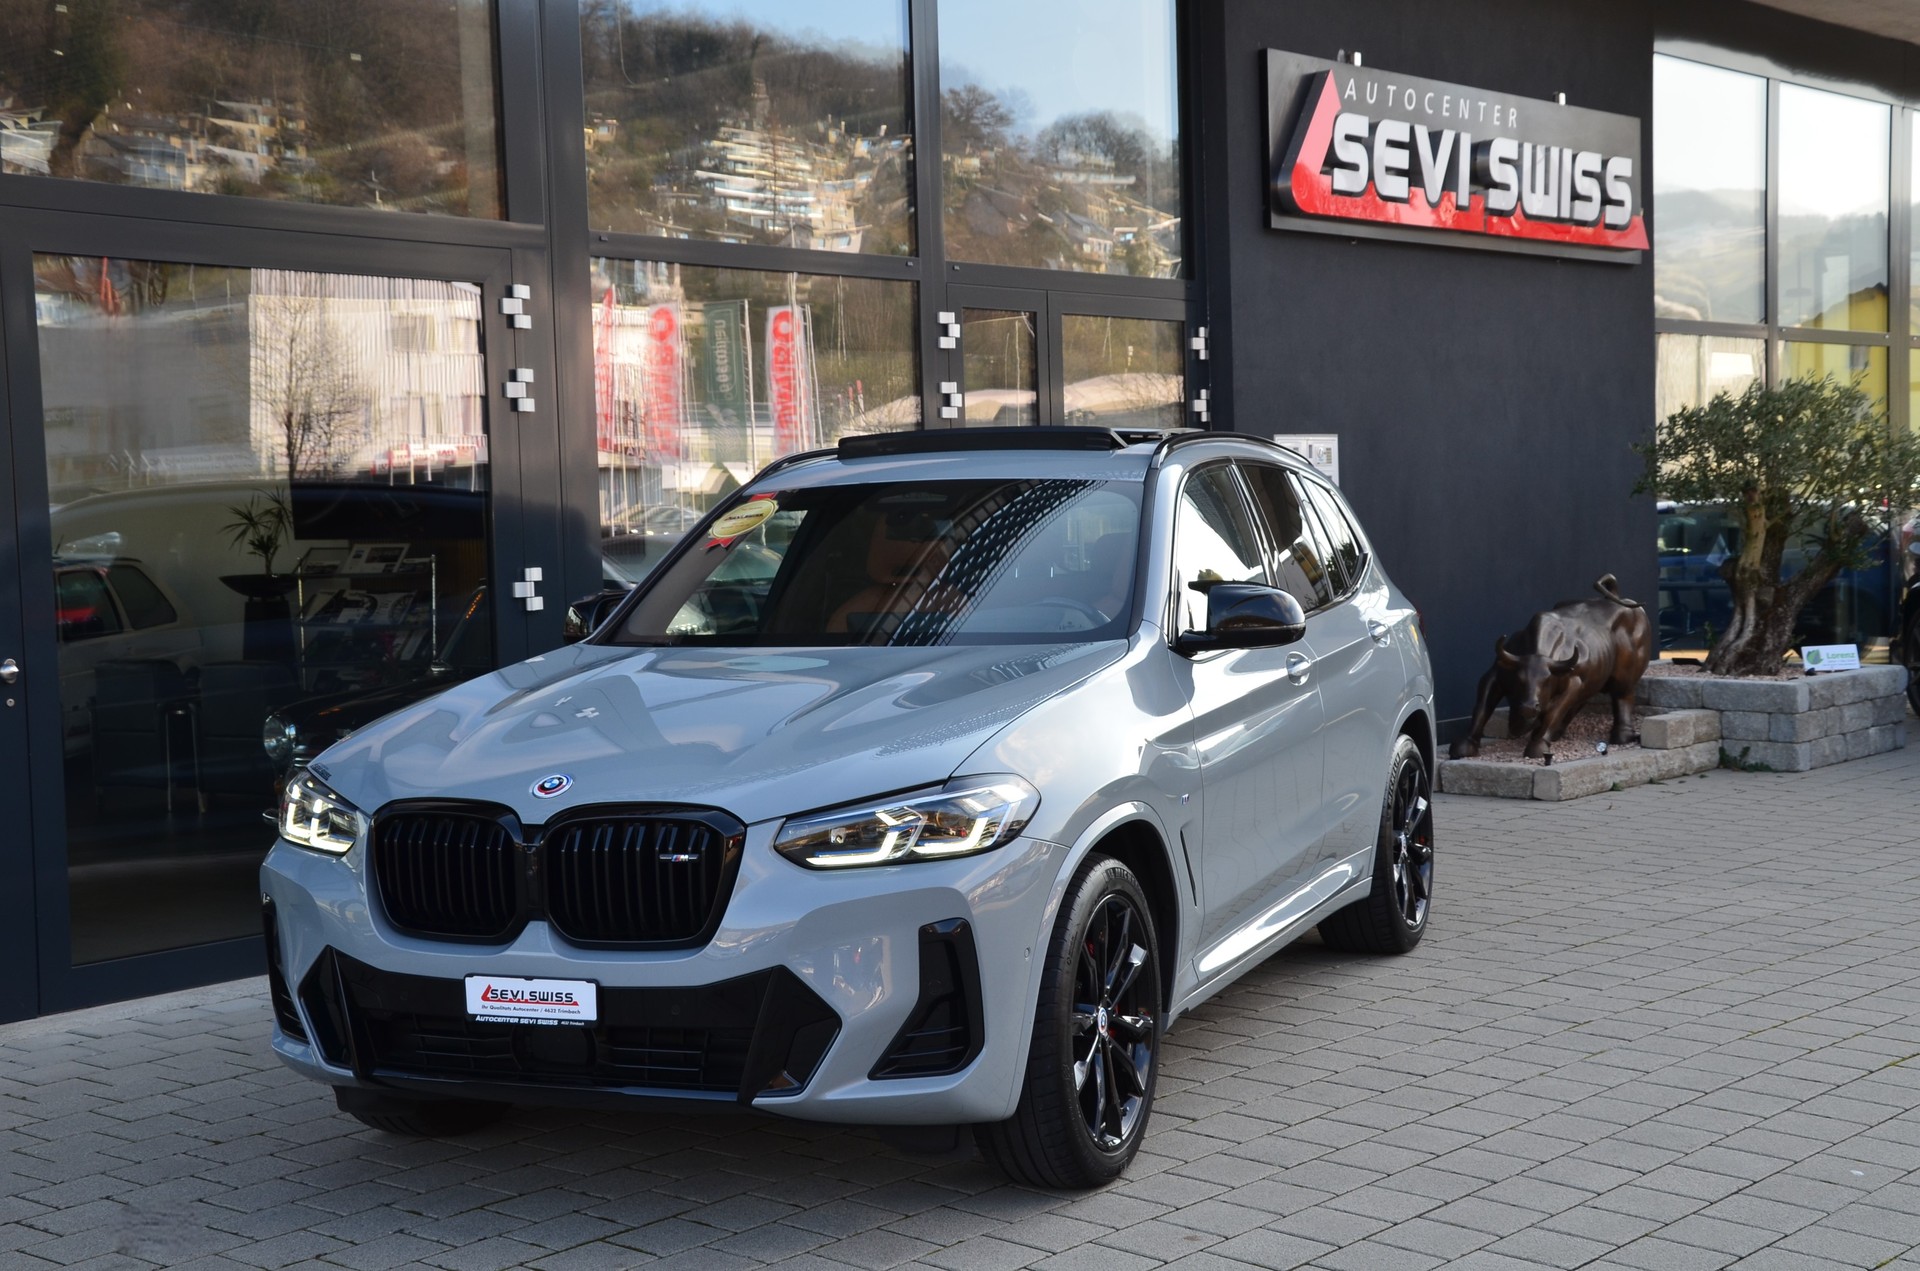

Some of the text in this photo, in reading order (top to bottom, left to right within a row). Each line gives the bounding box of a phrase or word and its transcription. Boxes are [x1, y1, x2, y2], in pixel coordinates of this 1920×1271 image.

[1344, 77, 1518, 129] AUTOCENTER
[1332, 111, 1633, 227] SEVI SWISS
[490, 989, 574, 1003] SEVI SWISS
